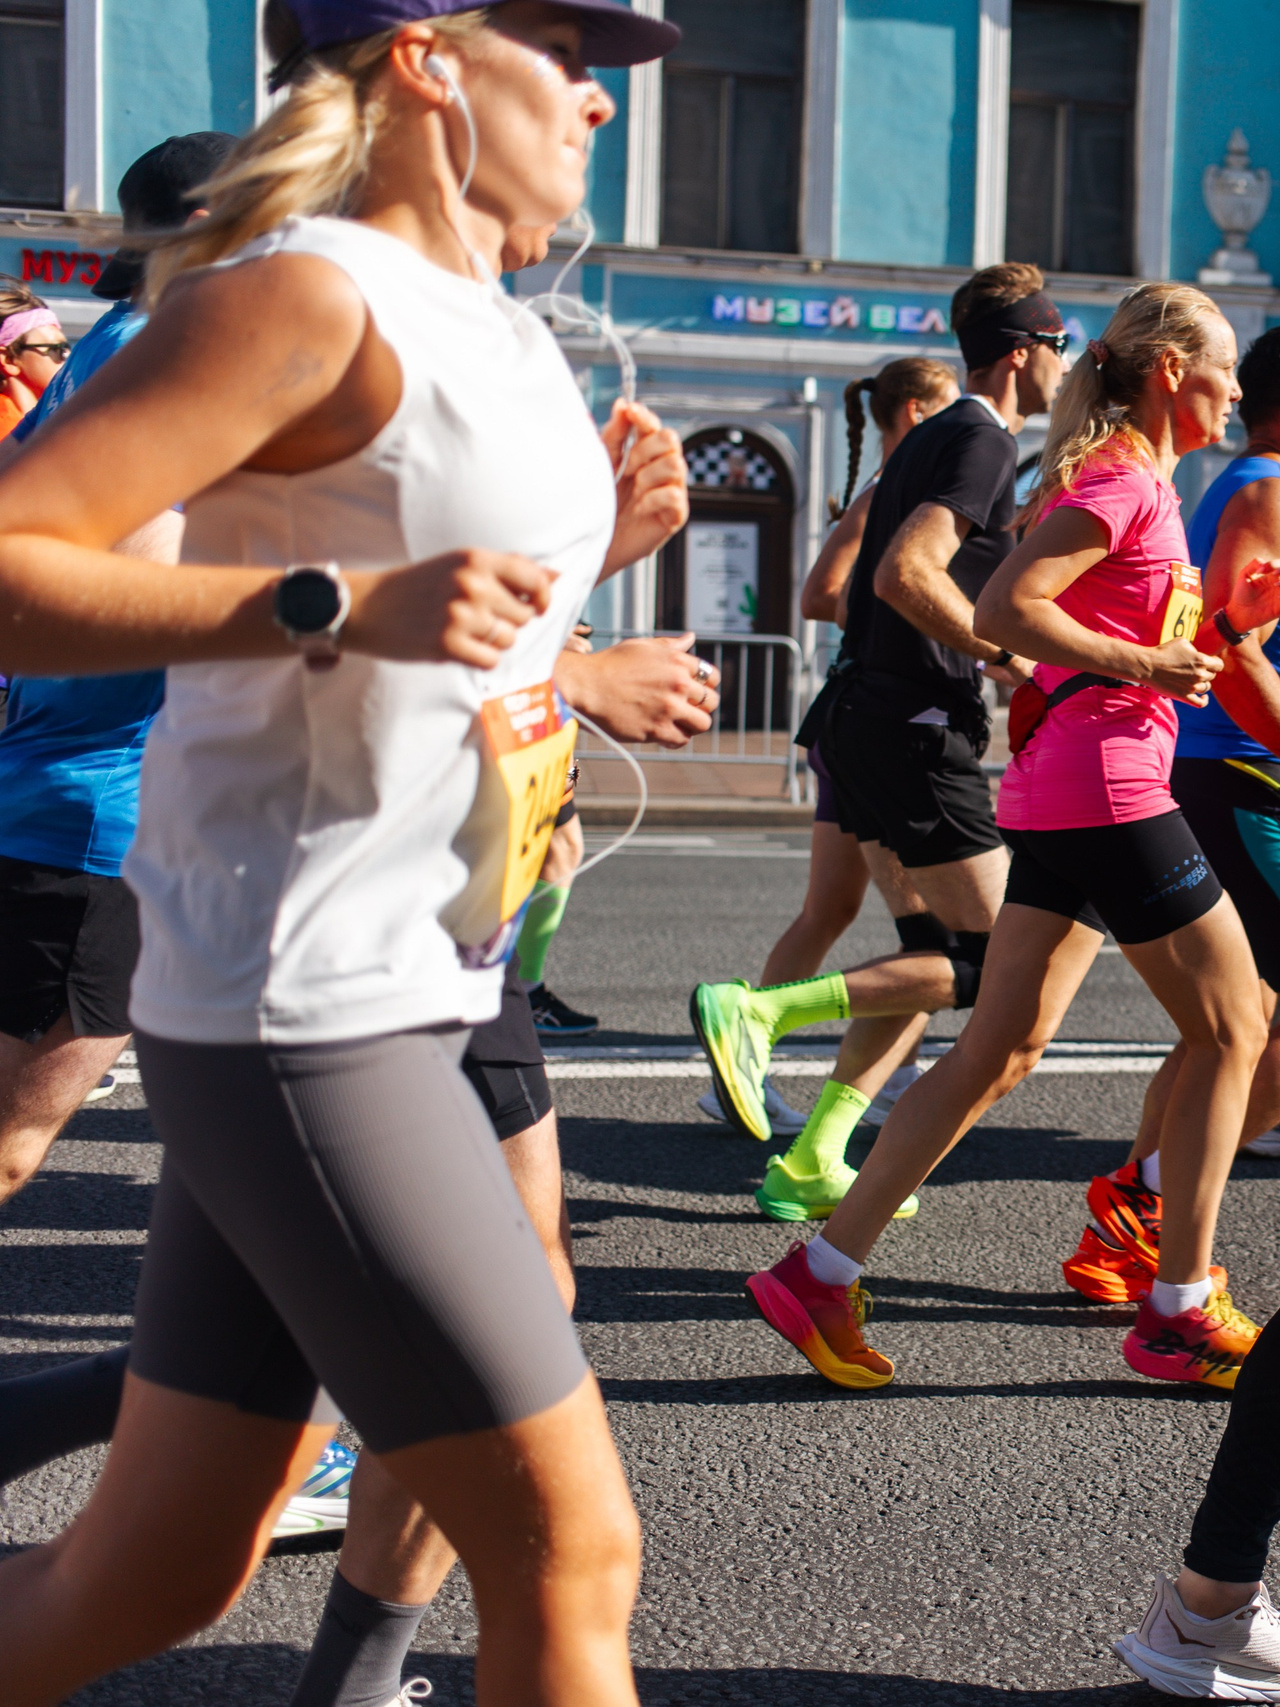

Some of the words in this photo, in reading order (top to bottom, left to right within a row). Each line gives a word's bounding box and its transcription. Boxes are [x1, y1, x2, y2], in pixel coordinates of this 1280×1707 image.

[22, 249, 115, 285] МУЗ
[712, 294, 860, 330] МУЗЕЙ
[1186, 867, 1208, 890] TEAM
